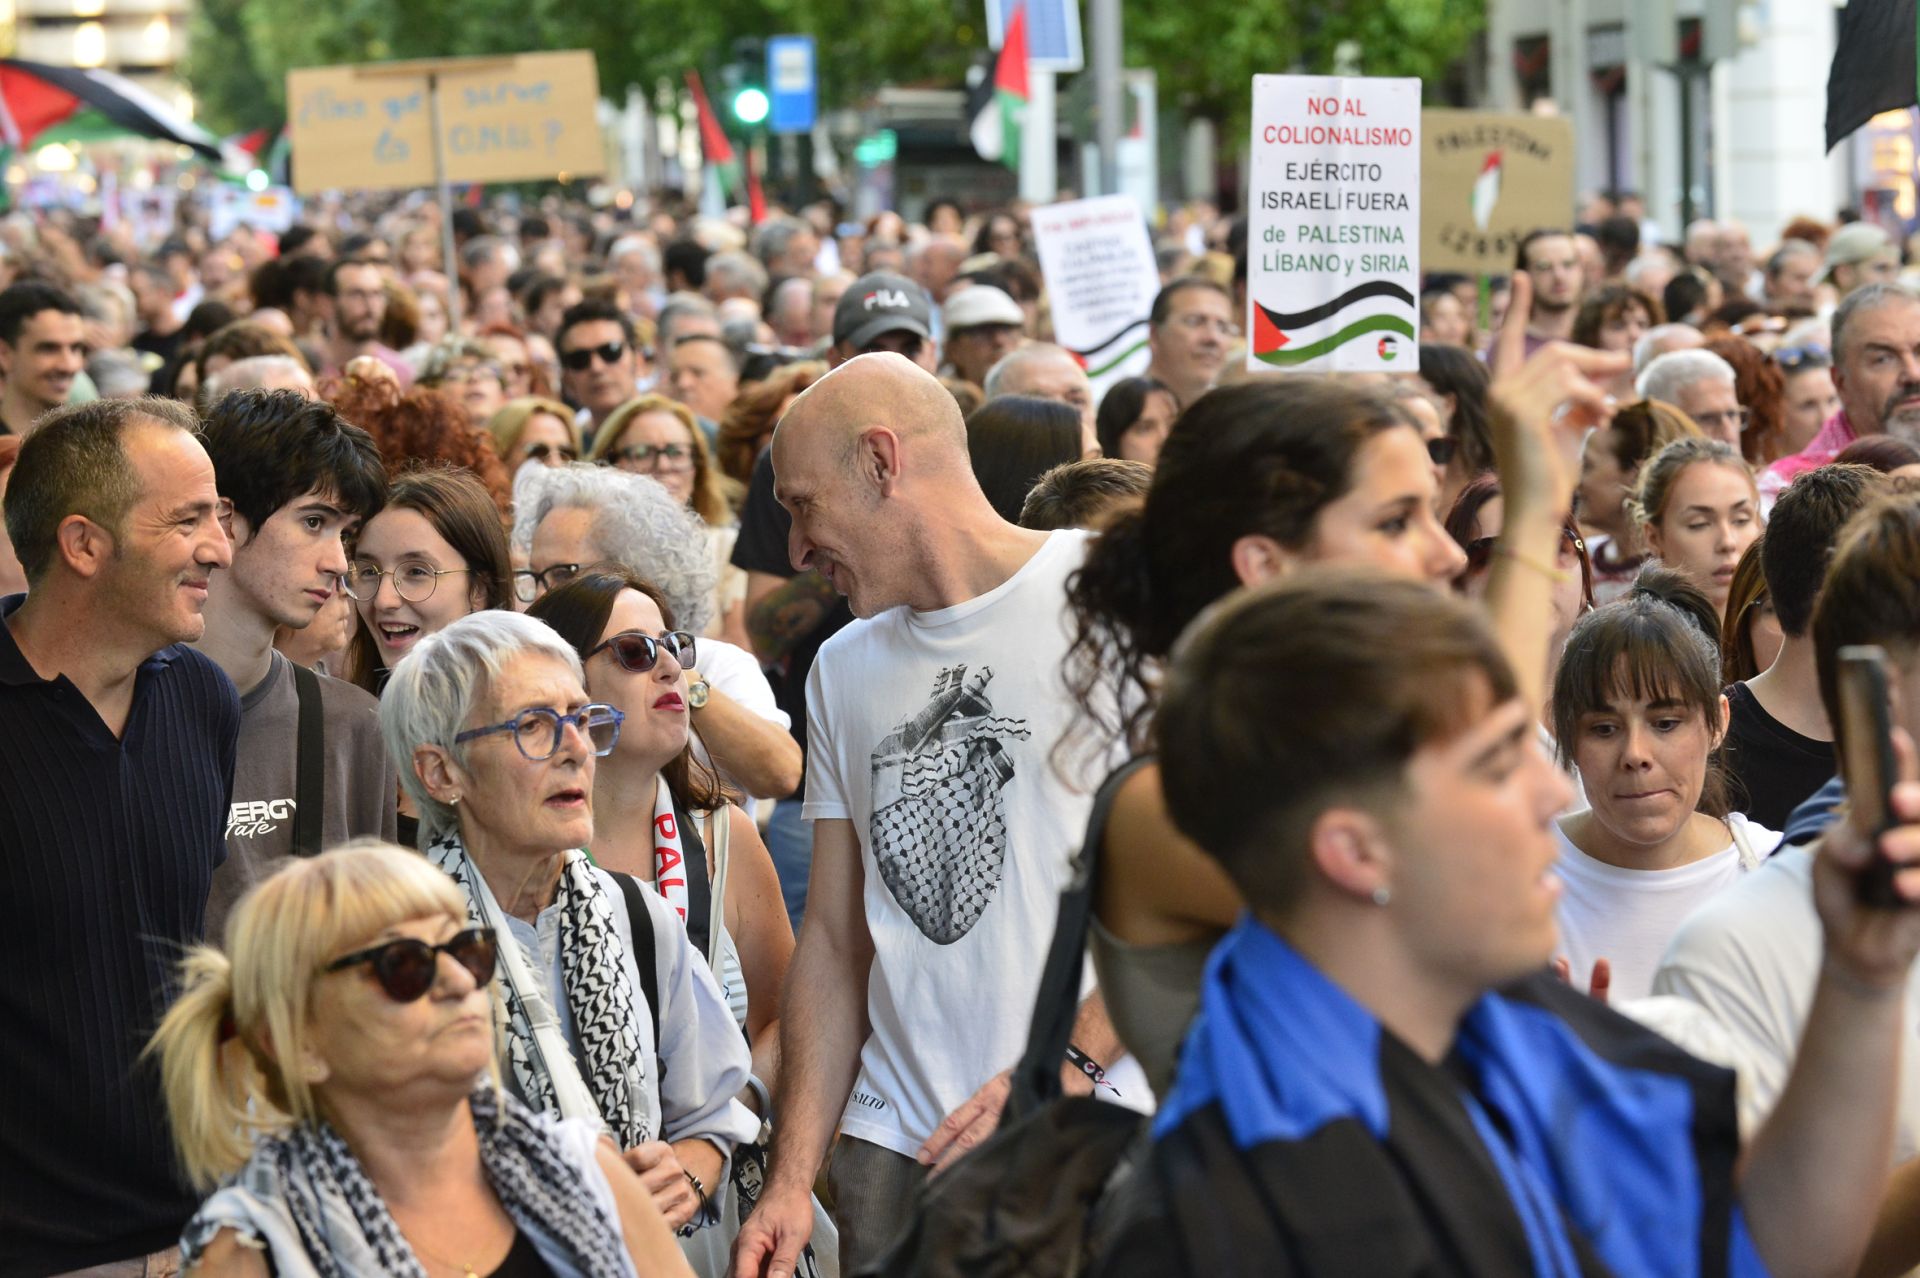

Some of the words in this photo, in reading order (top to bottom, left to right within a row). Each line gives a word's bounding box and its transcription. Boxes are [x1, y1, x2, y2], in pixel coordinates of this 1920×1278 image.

[1307, 97, 1340, 116] NO
[1344, 98, 1367, 117] AL
[1263, 125, 1413, 147] COLIONALISMO
[1286, 158, 1383, 182] EJÉRCITO
[1261, 187, 1343, 211] ISRAELÍ
[1346, 192, 1410, 211] FUERA
[1263, 225, 1287, 243] de
[1298, 225, 1405, 244] PALESTINA
[1262, 249, 1341, 273] LÍBANO
[1344, 257, 1355, 277] y
[1360, 254, 1411, 273] SIRIA
[863, 289, 911, 312] FILA
[227, 798, 297, 823] ERG
[655, 812, 687, 923] PAL
[850, 1090, 887, 1110] SALTO
